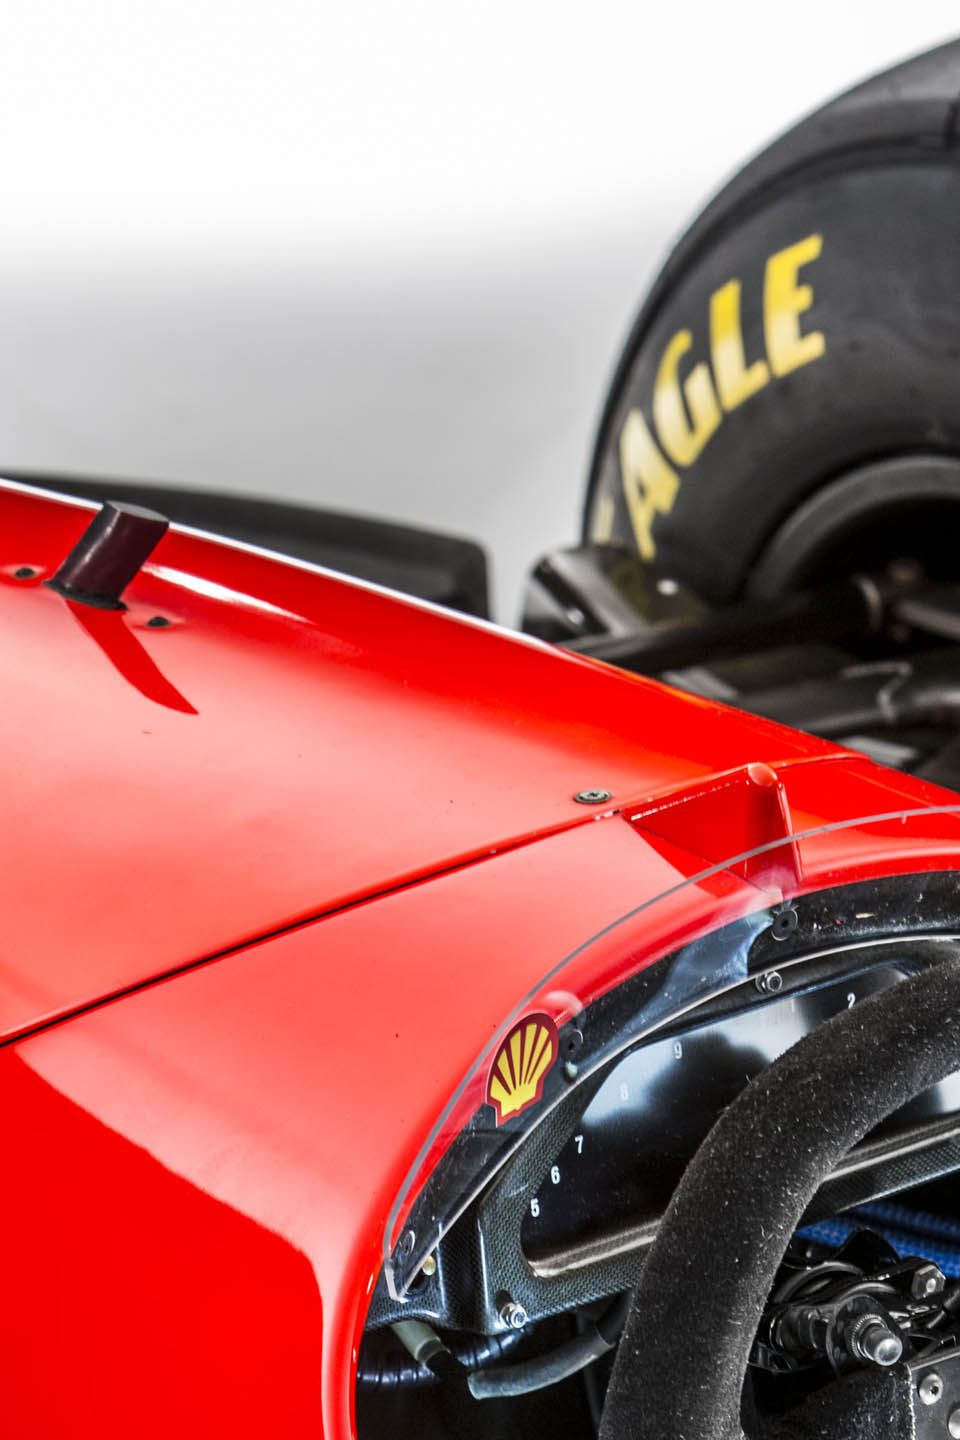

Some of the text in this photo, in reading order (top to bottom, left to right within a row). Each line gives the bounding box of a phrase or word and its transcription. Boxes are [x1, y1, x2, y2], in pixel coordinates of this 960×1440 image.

[574, 1135, 584, 1154] 7
[551, 1165, 560, 1184] 6
[530, 1198, 540, 1217] 5
